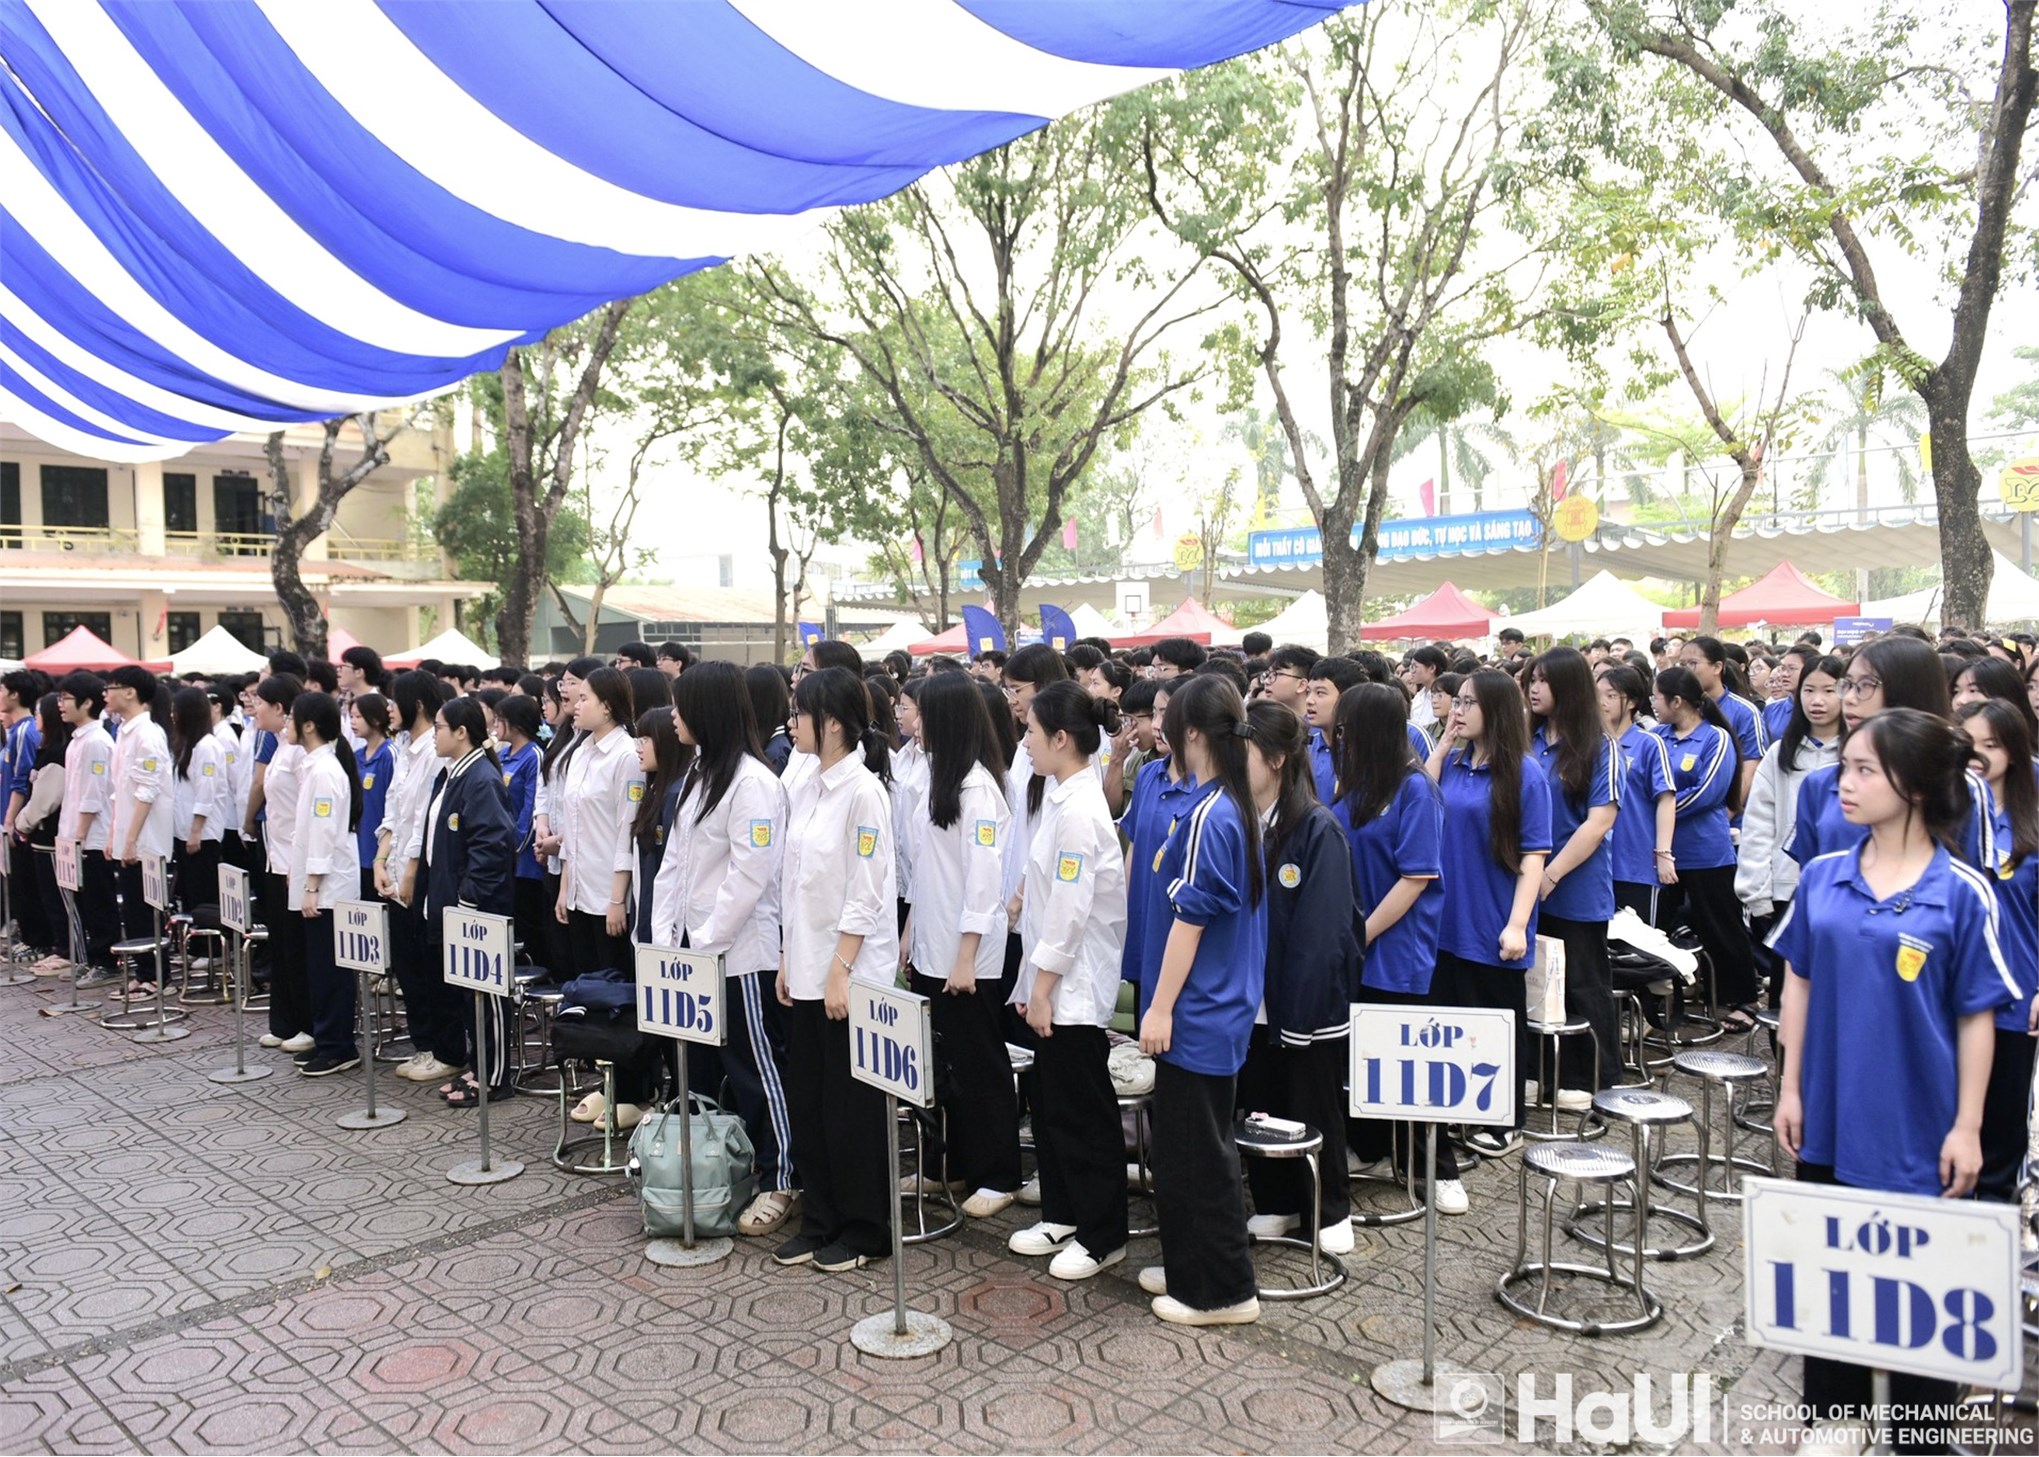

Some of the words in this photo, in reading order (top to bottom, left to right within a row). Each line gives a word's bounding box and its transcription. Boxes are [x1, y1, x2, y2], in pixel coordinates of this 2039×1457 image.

[1484, 519, 1511, 541] SÁNG
[222, 892, 243, 925] 11D2
[348, 907, 367, 927] LỚP
[462, 919, 487, 941] LỚP
[338, 930, 380, 965] 11D3
[449, 943, 503, 986] 11D4
[660, 956, 693, 981] LỚP
[643, 985, 713, 1033] 11D5
[869, 996, 898, 1027] LỚP
[1400, 1017, 1464, 1048] LỚP
[855, 1025, 918, 1091] 11D6
[1362, 1057, 1501, 1112] 11D7
[1824, 1210, 1930, 1259] LỚP
[1767, 1259, 1998, 1362] 11D8
